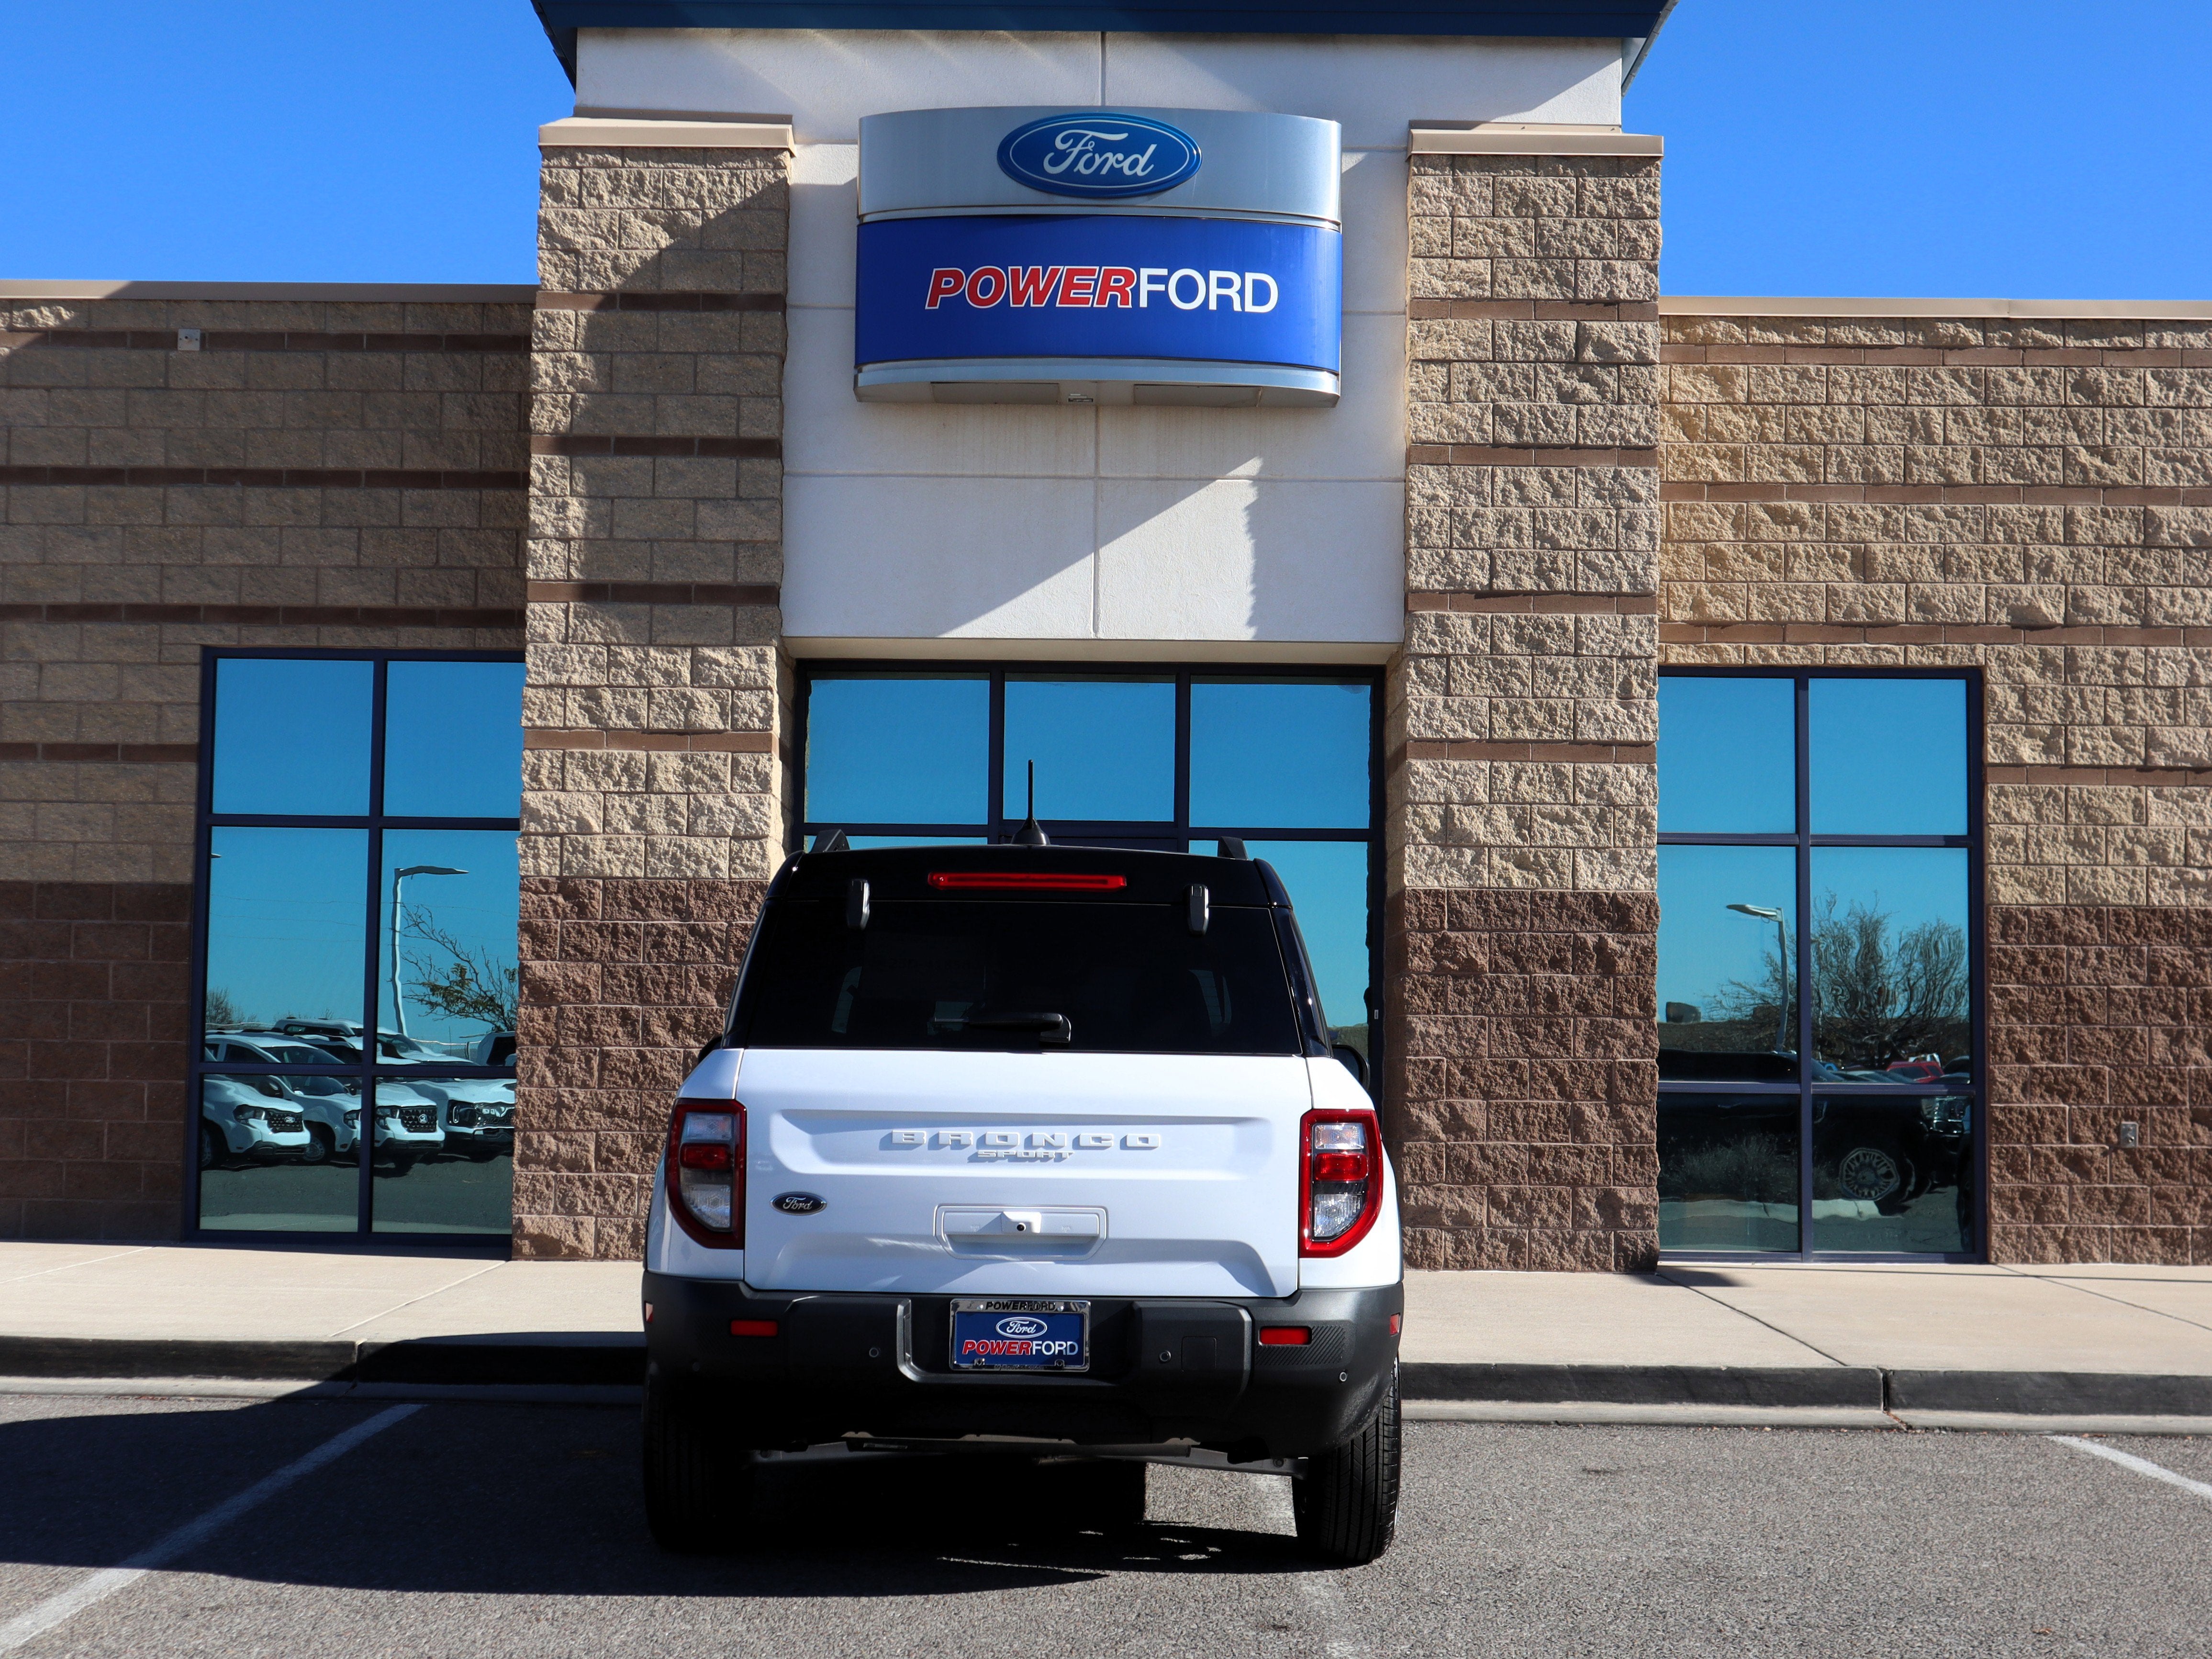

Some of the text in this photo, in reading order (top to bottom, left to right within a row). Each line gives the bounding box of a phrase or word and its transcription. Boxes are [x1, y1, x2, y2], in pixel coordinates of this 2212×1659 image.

[1043, 129, 1157, 177] Ford
[924, 265, 1279, 313] POWERFORD
[892, 1131, 1160, 1148] BRONCO
[977, 1150, 1074, 1158] SPORT
[782, 1197, 813, 1210] Ford
[1006, 1321, 1037, 1334] Ford
[962, 1340, 1078, 1356] POWERFORD
